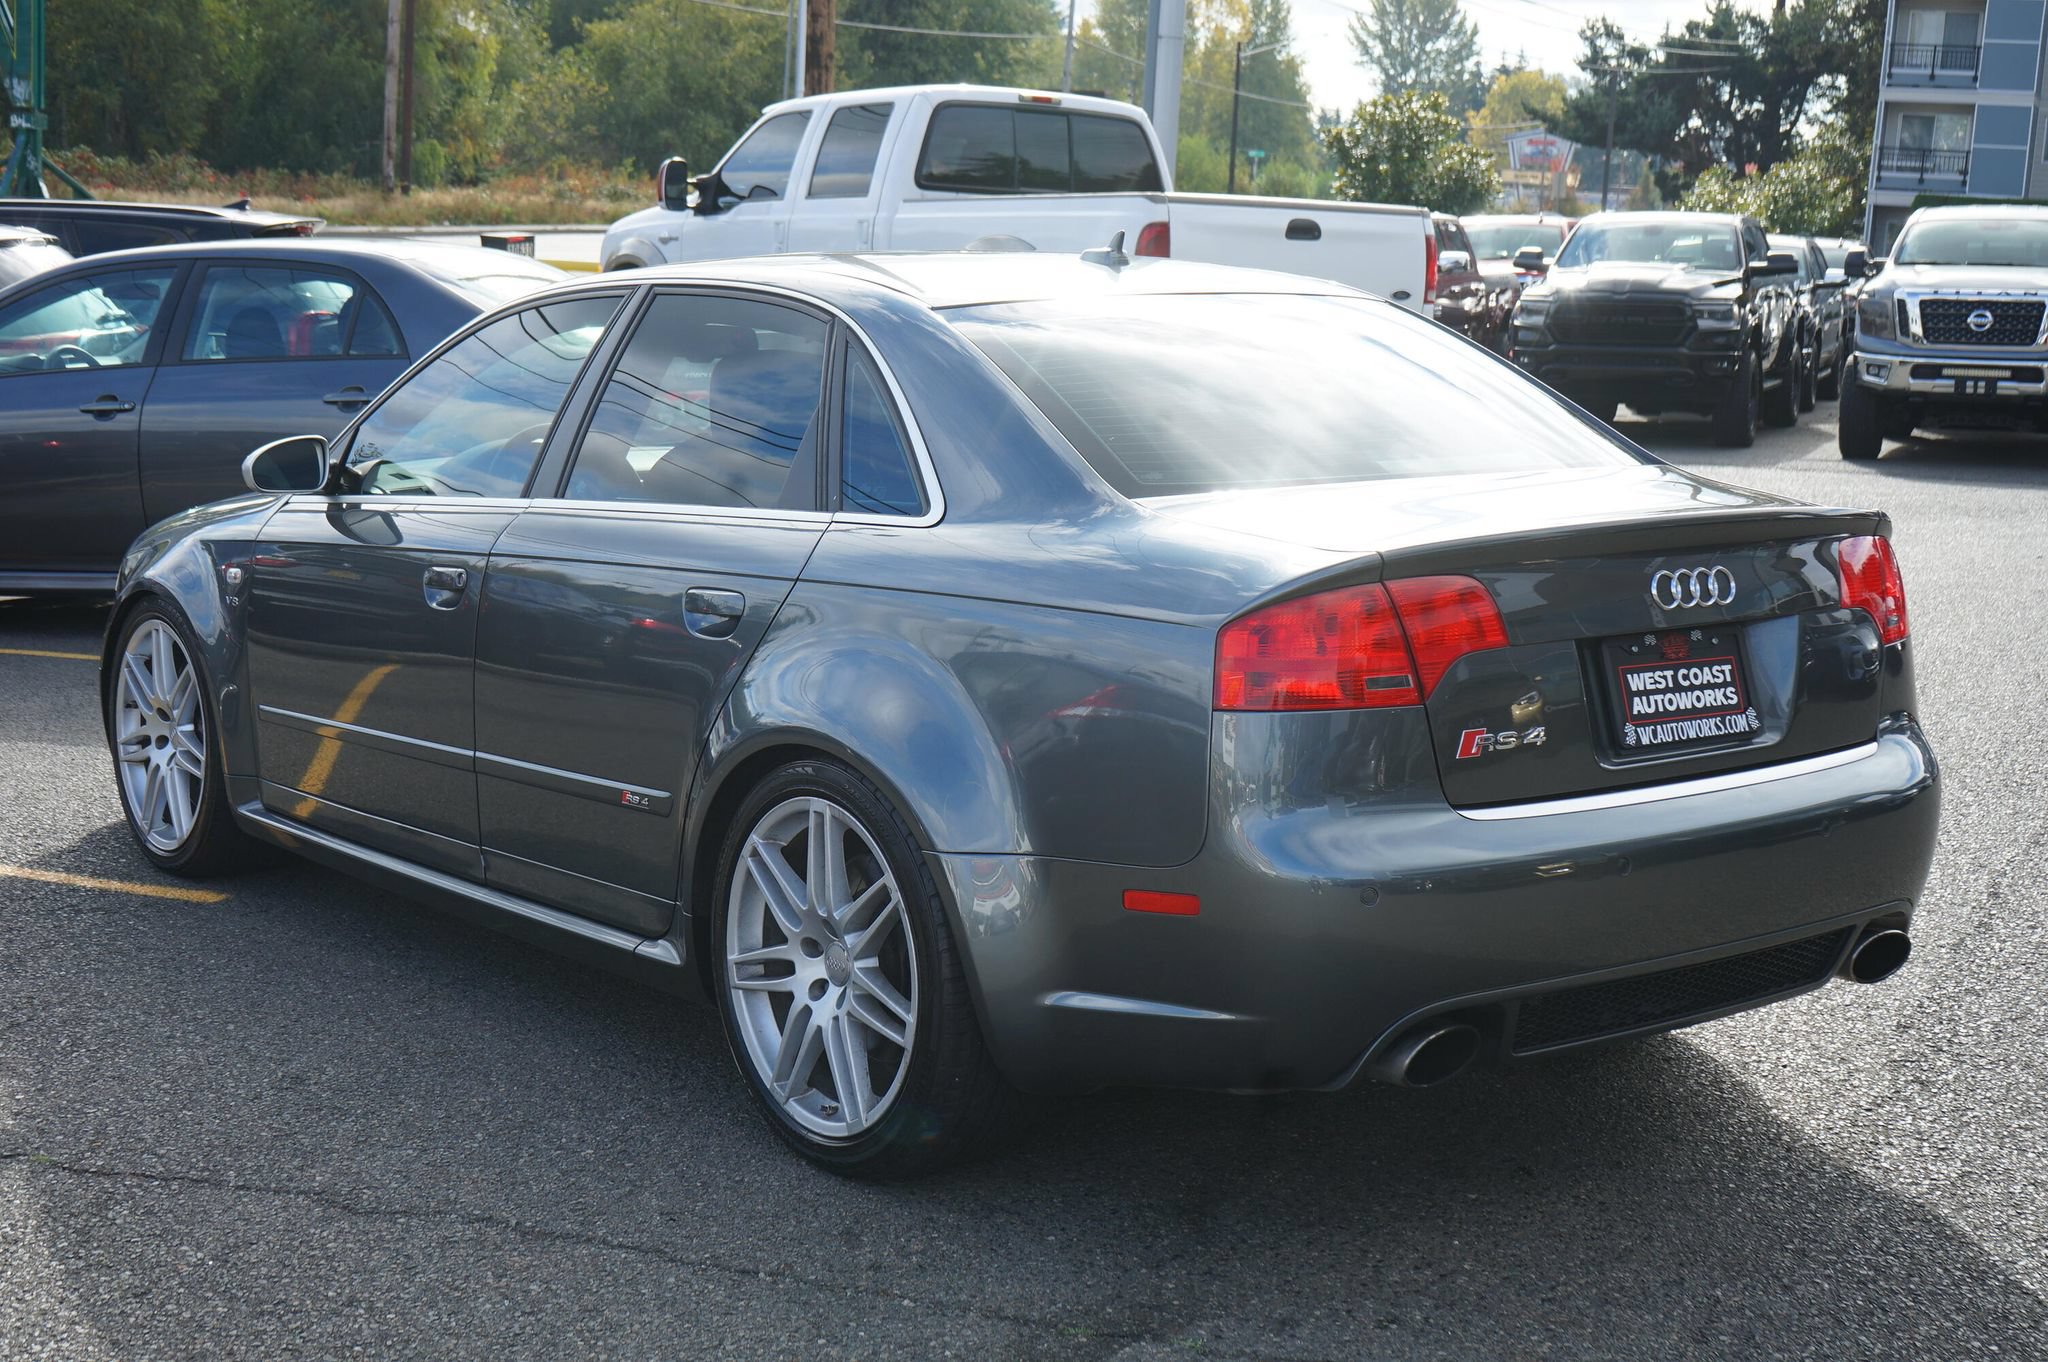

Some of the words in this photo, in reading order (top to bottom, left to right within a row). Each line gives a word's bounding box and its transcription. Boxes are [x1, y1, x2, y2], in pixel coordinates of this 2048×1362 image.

[1626, 669, 1674, 691] WEST
[1677, 664, 1732, 686] COAST
[1632, 687, 1738, 715] AUTOWORKS
[1637, 713, 1749, 745] WCAUTOWORKS.COM
